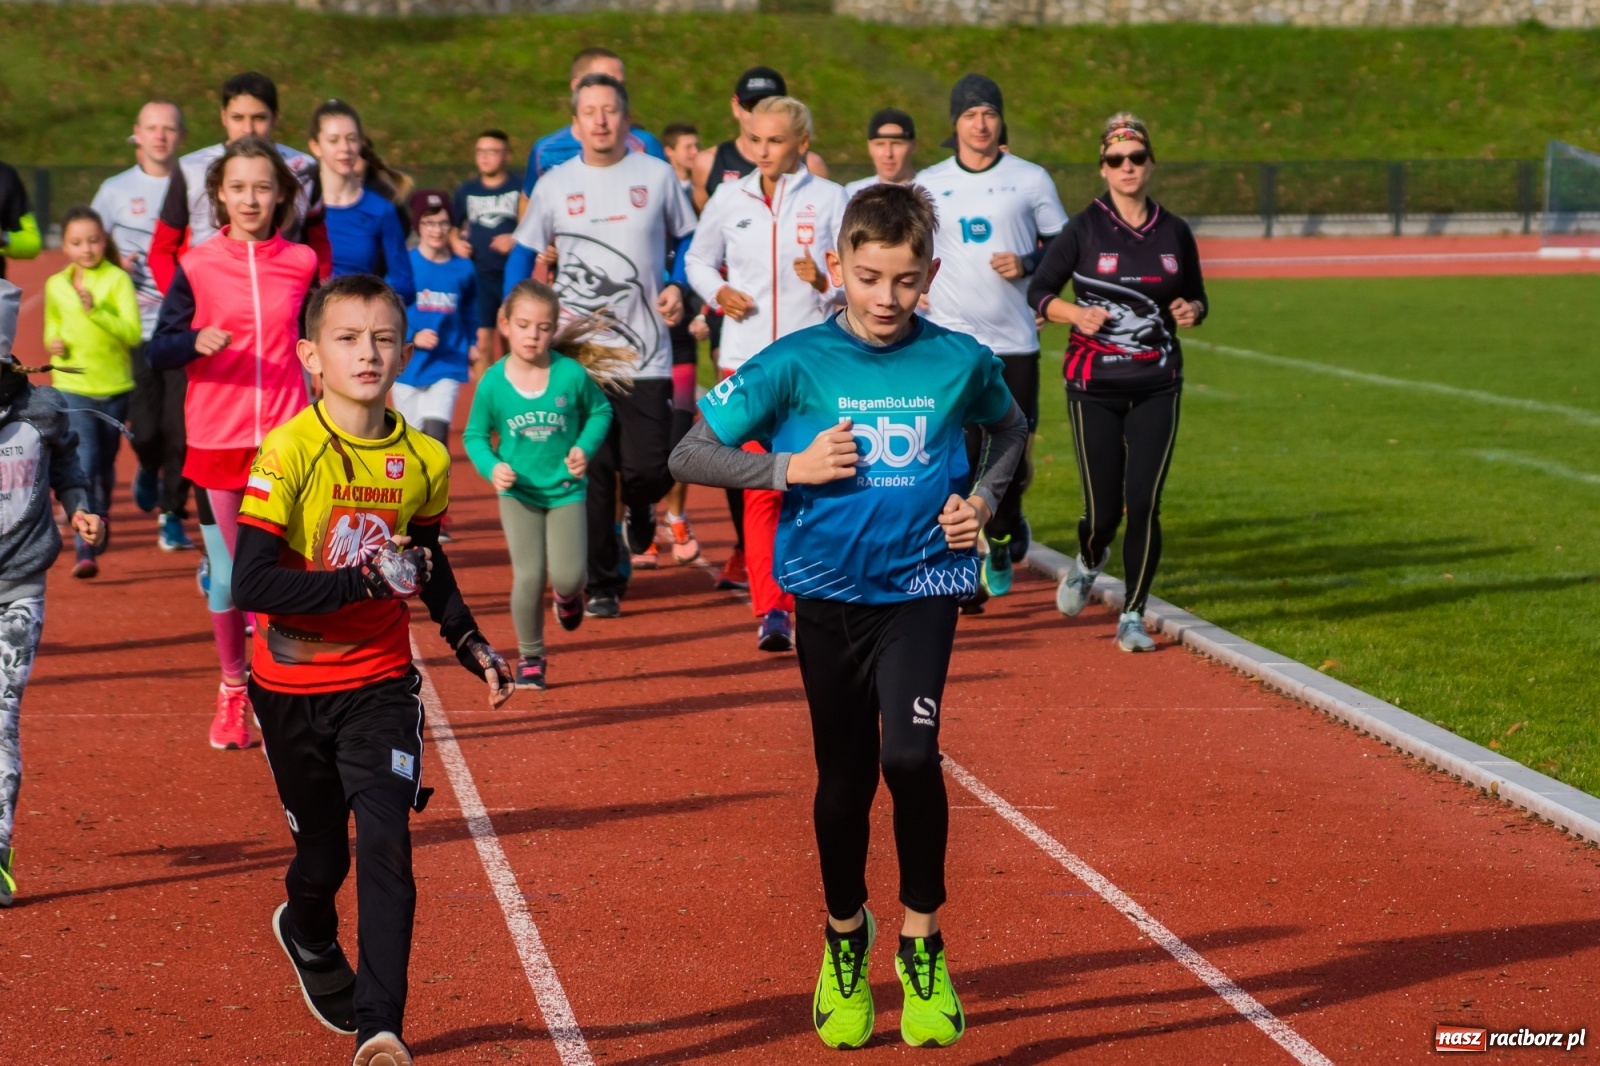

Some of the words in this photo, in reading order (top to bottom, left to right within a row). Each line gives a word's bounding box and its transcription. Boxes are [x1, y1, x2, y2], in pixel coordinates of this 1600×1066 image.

[838, 396, 935, 410] BiegamBoLubię
[14, 445, 24, 455] TO
[857, 475, 916, 488] RACIBÓRZ
[331, 483, 404, 505] RACIBORKI
